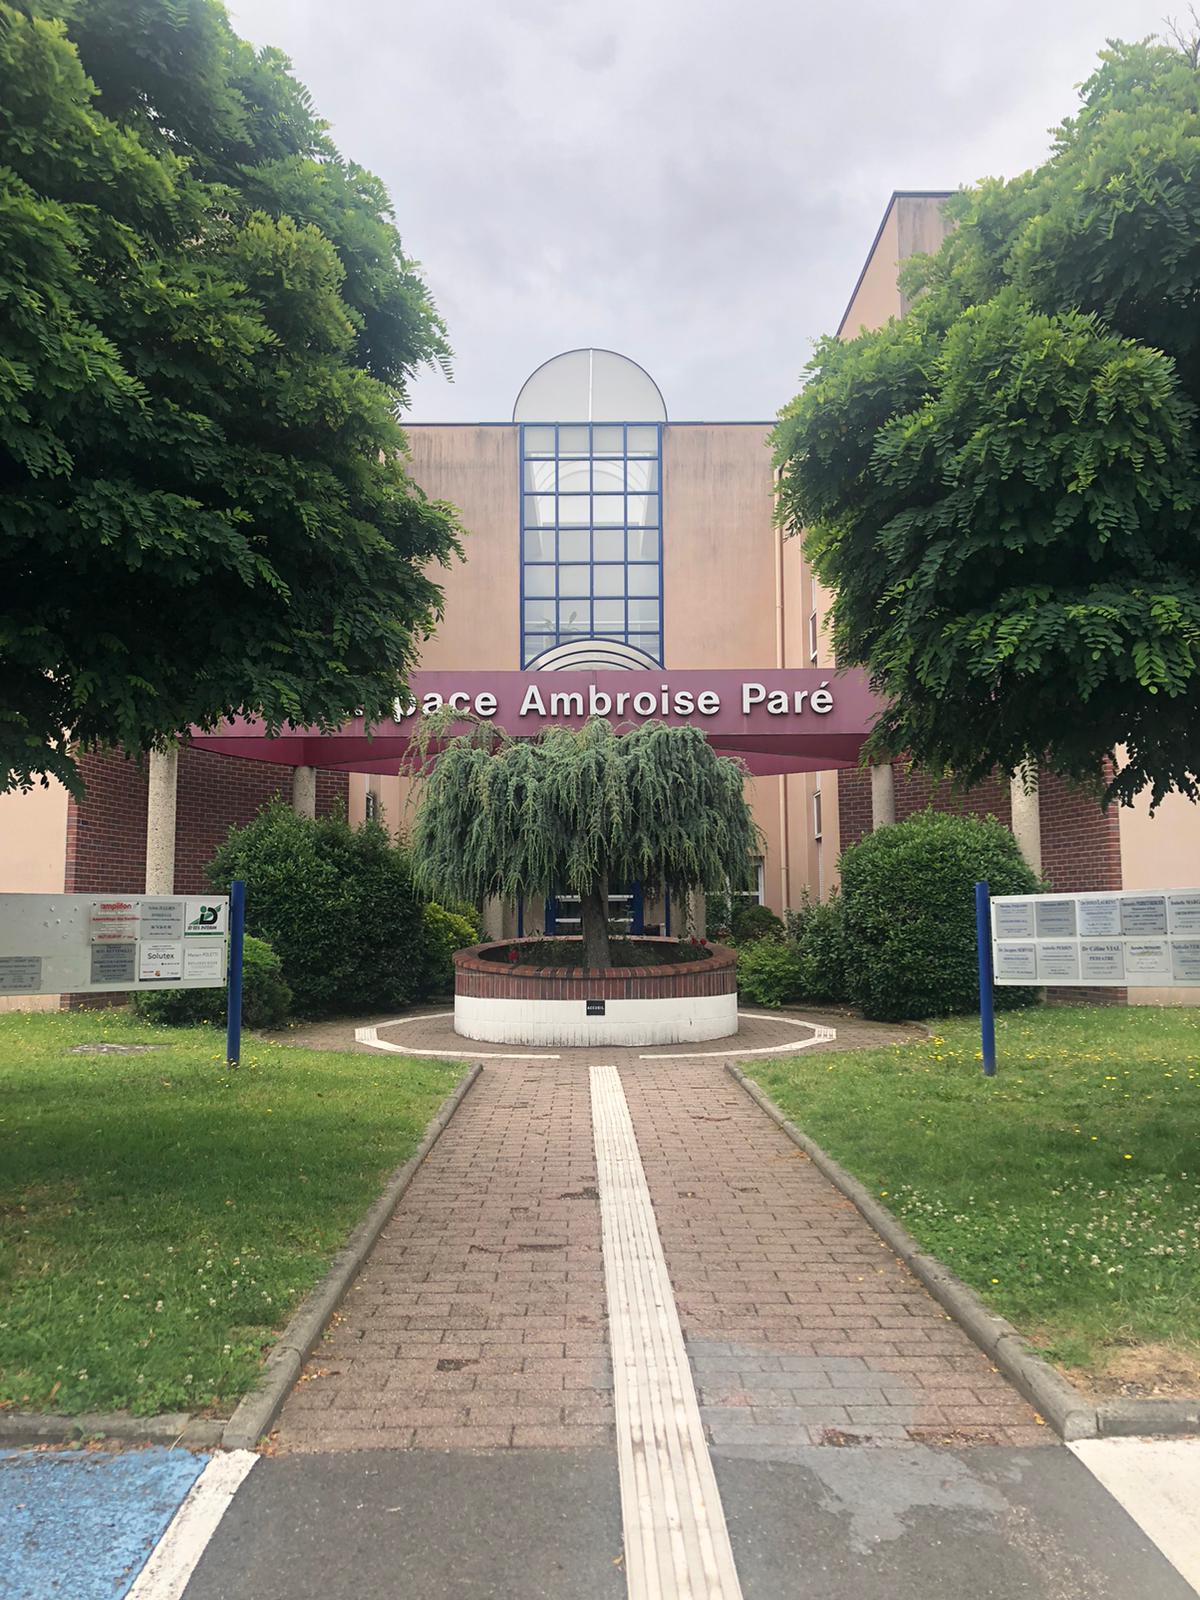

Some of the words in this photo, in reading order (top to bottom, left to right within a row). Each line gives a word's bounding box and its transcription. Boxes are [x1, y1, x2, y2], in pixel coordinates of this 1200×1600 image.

[338, 691, 498, 723] pace
[519, 684, 721, 716] Ambroise
[741, 681, 834, 715] Paré
[100, 902, 132, 911] amplifon
[147, 952, 175, 960] Solutex
